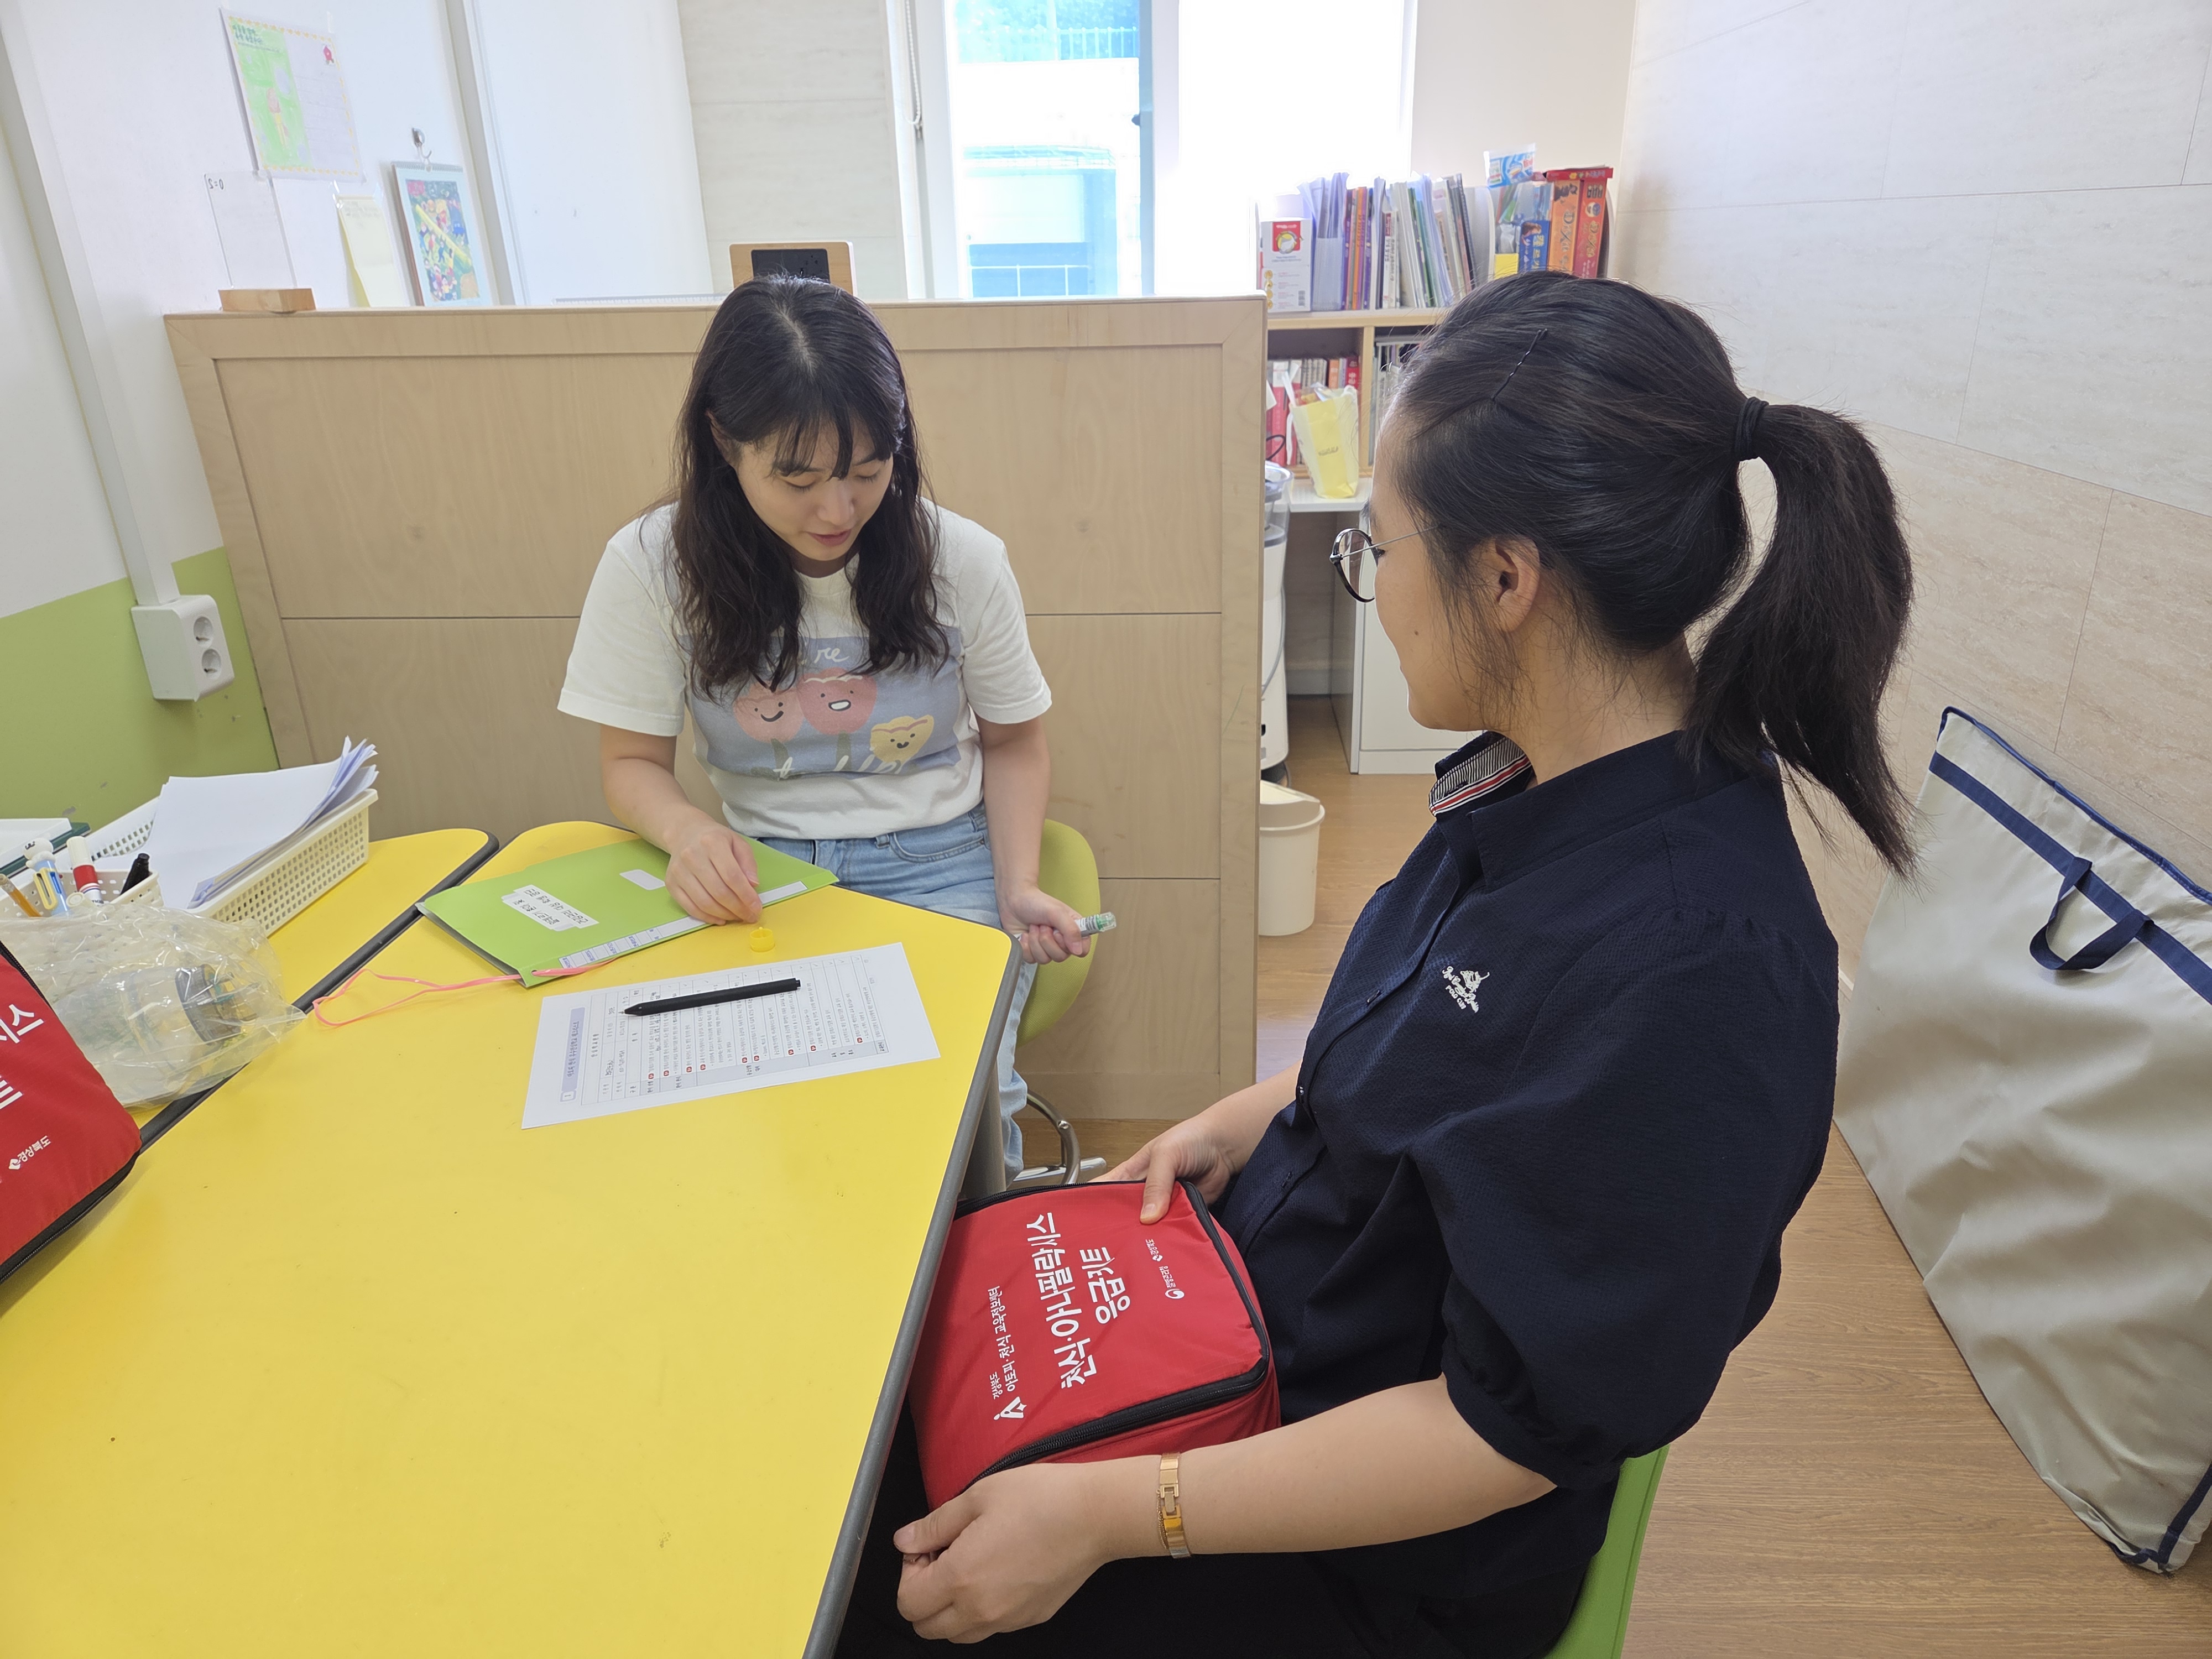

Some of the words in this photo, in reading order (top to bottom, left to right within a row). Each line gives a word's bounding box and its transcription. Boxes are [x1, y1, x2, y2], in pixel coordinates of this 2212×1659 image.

[17, 1135, 51, 1162] 경상북도
[1145, 1239, 1159, 1256] 경상북도
[1079, 1246, 1131, 1324] 응급키트
[1159, 1266, 1176, 1288] 질병관리청
[988, 1285, 1007, 1334] 교육정보센터
[1026, 1212, 1097, 1389] 천식·아나필락시스
[996, 1334, 1019, 1392] 아토피·천식
[989, 1371, 1003, 1400] 경상북도
